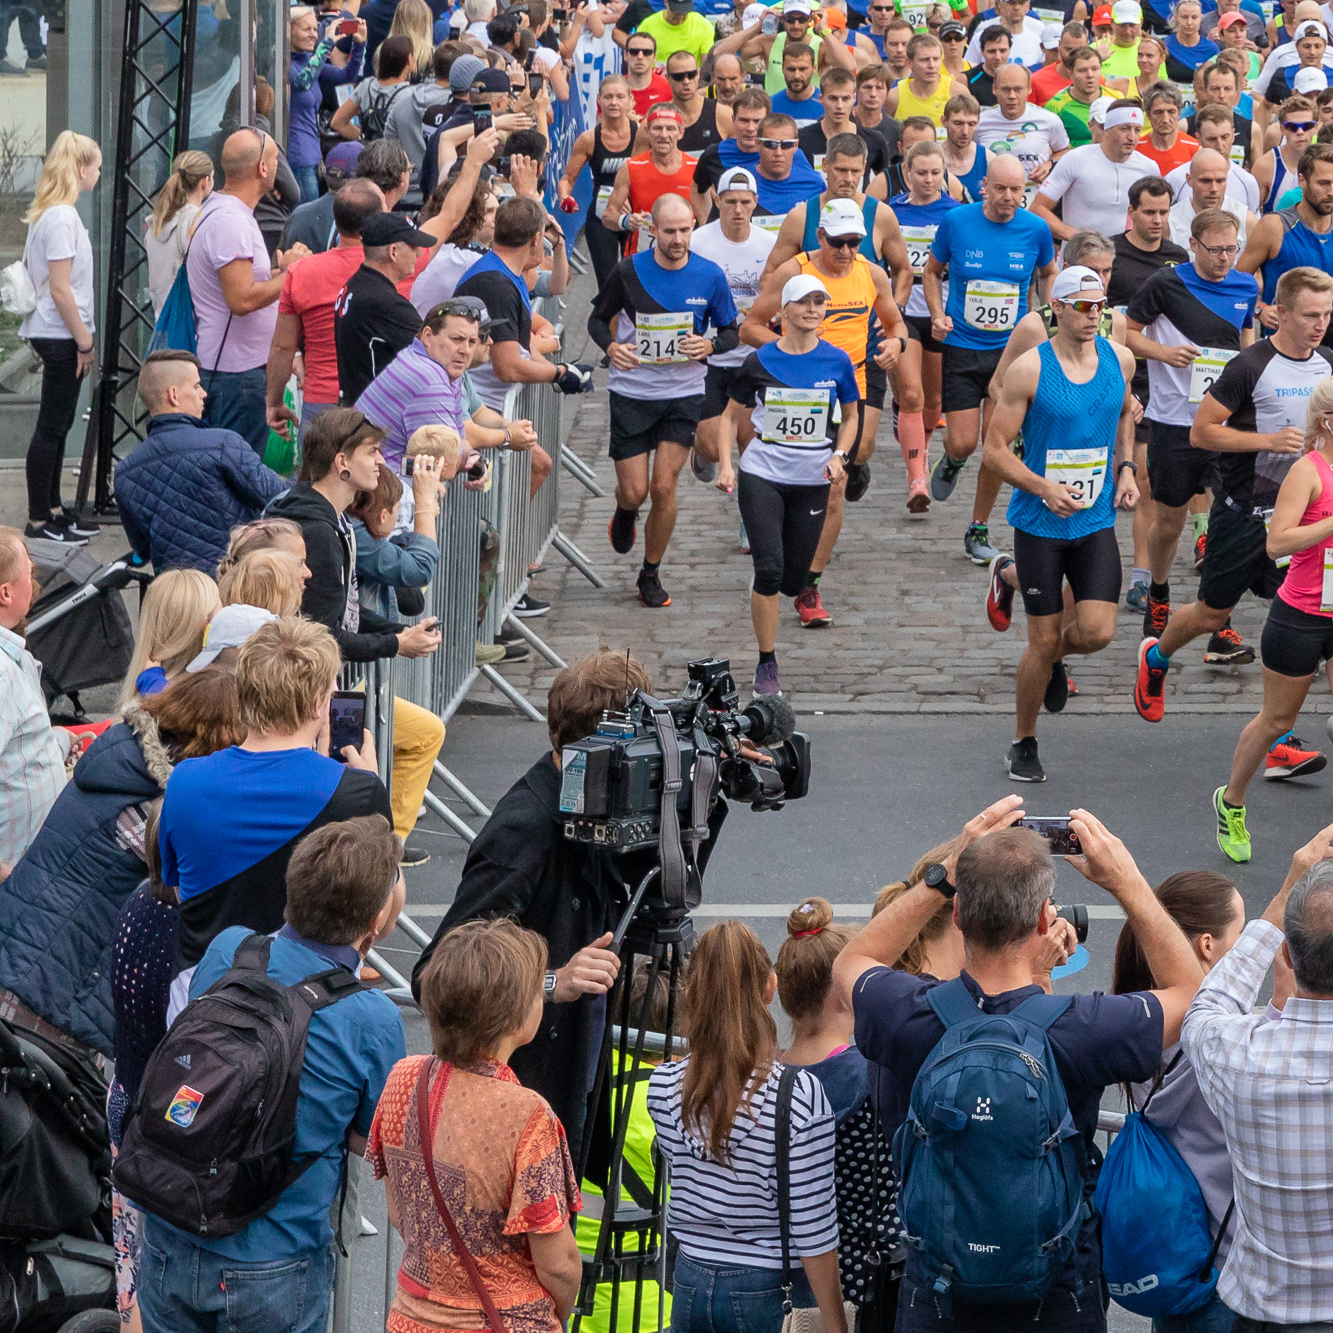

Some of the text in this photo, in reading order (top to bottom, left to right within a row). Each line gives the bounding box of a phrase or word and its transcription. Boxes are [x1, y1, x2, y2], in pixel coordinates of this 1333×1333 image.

[909, 14, 924, 26] 92
[975, 306, 1010, 325] 295
[1087, 380, 1114, 417] CRAFT
[776, 417, 816, 435] 450
[971, 1113, 994, 1121] Haglöfs
